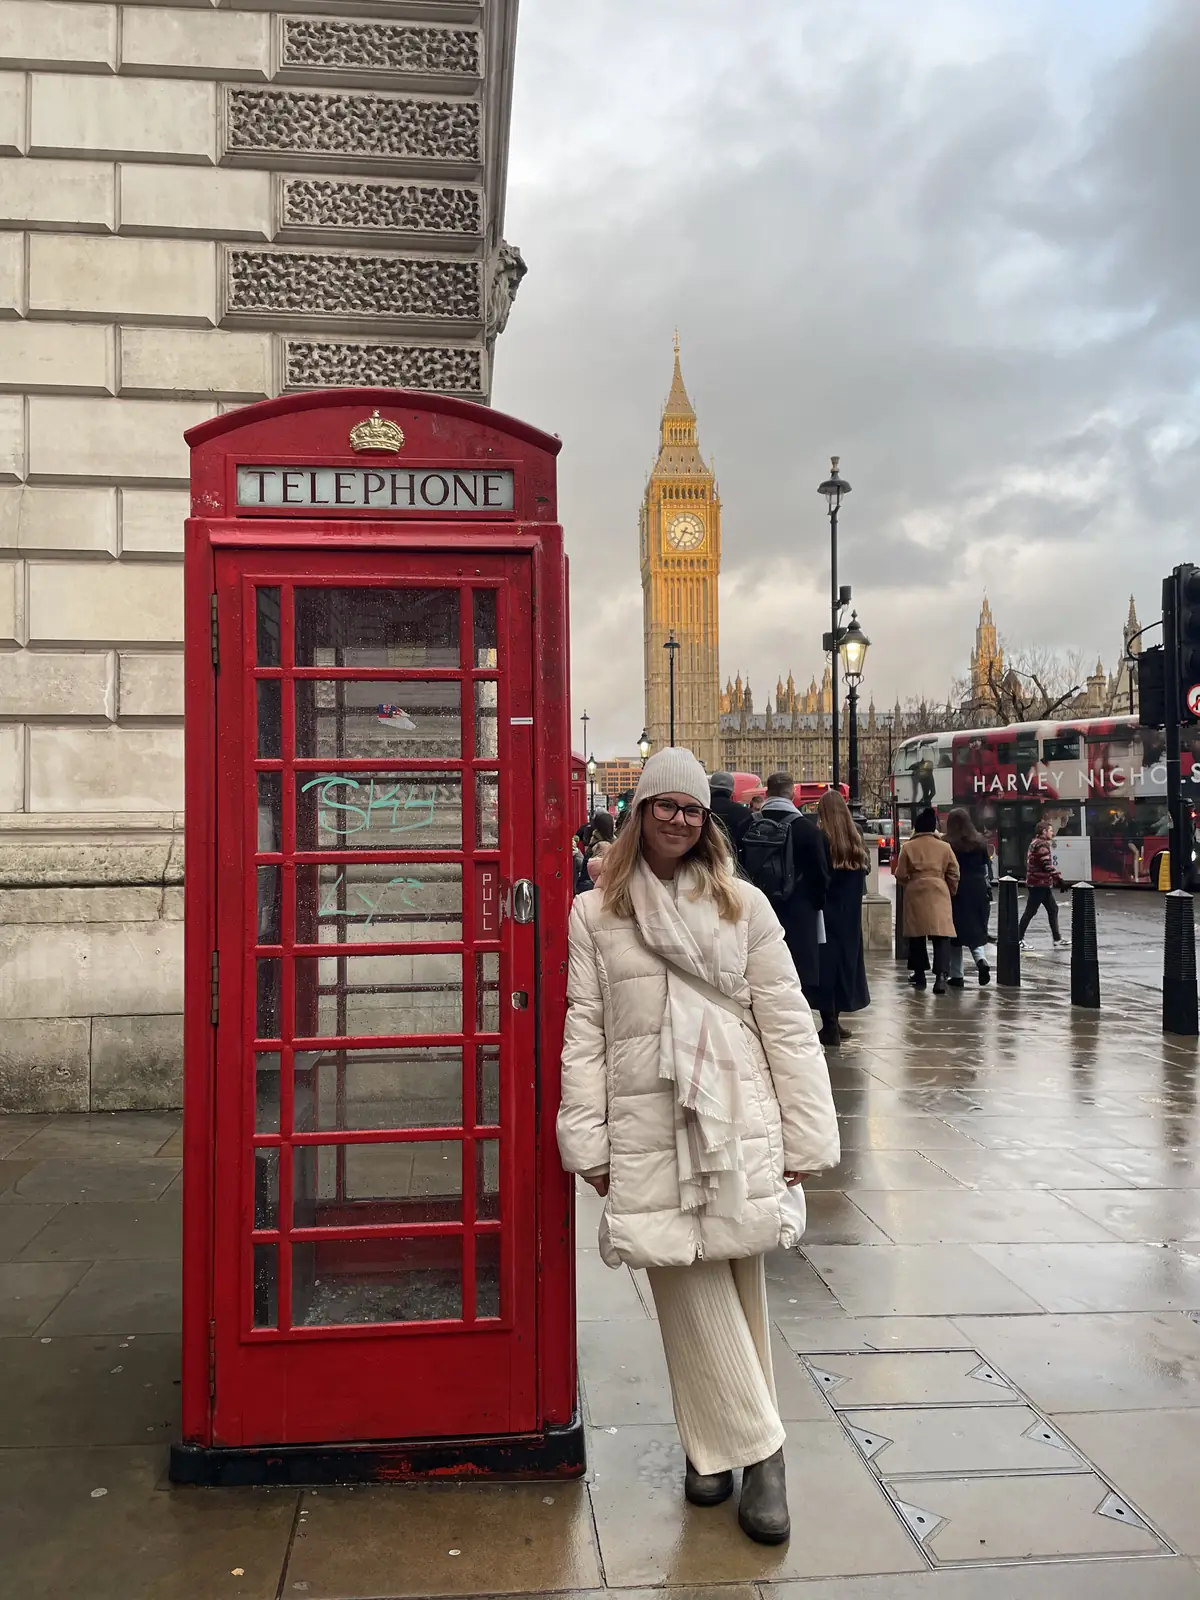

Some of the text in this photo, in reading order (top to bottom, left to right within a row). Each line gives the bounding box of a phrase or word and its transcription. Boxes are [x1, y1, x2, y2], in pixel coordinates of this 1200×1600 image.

[248, 470, 503, 507] TELEPHONE
[974, 762, 1200, 793] HARVEY NICHOS
[482, 873, 492, 930] PULL
